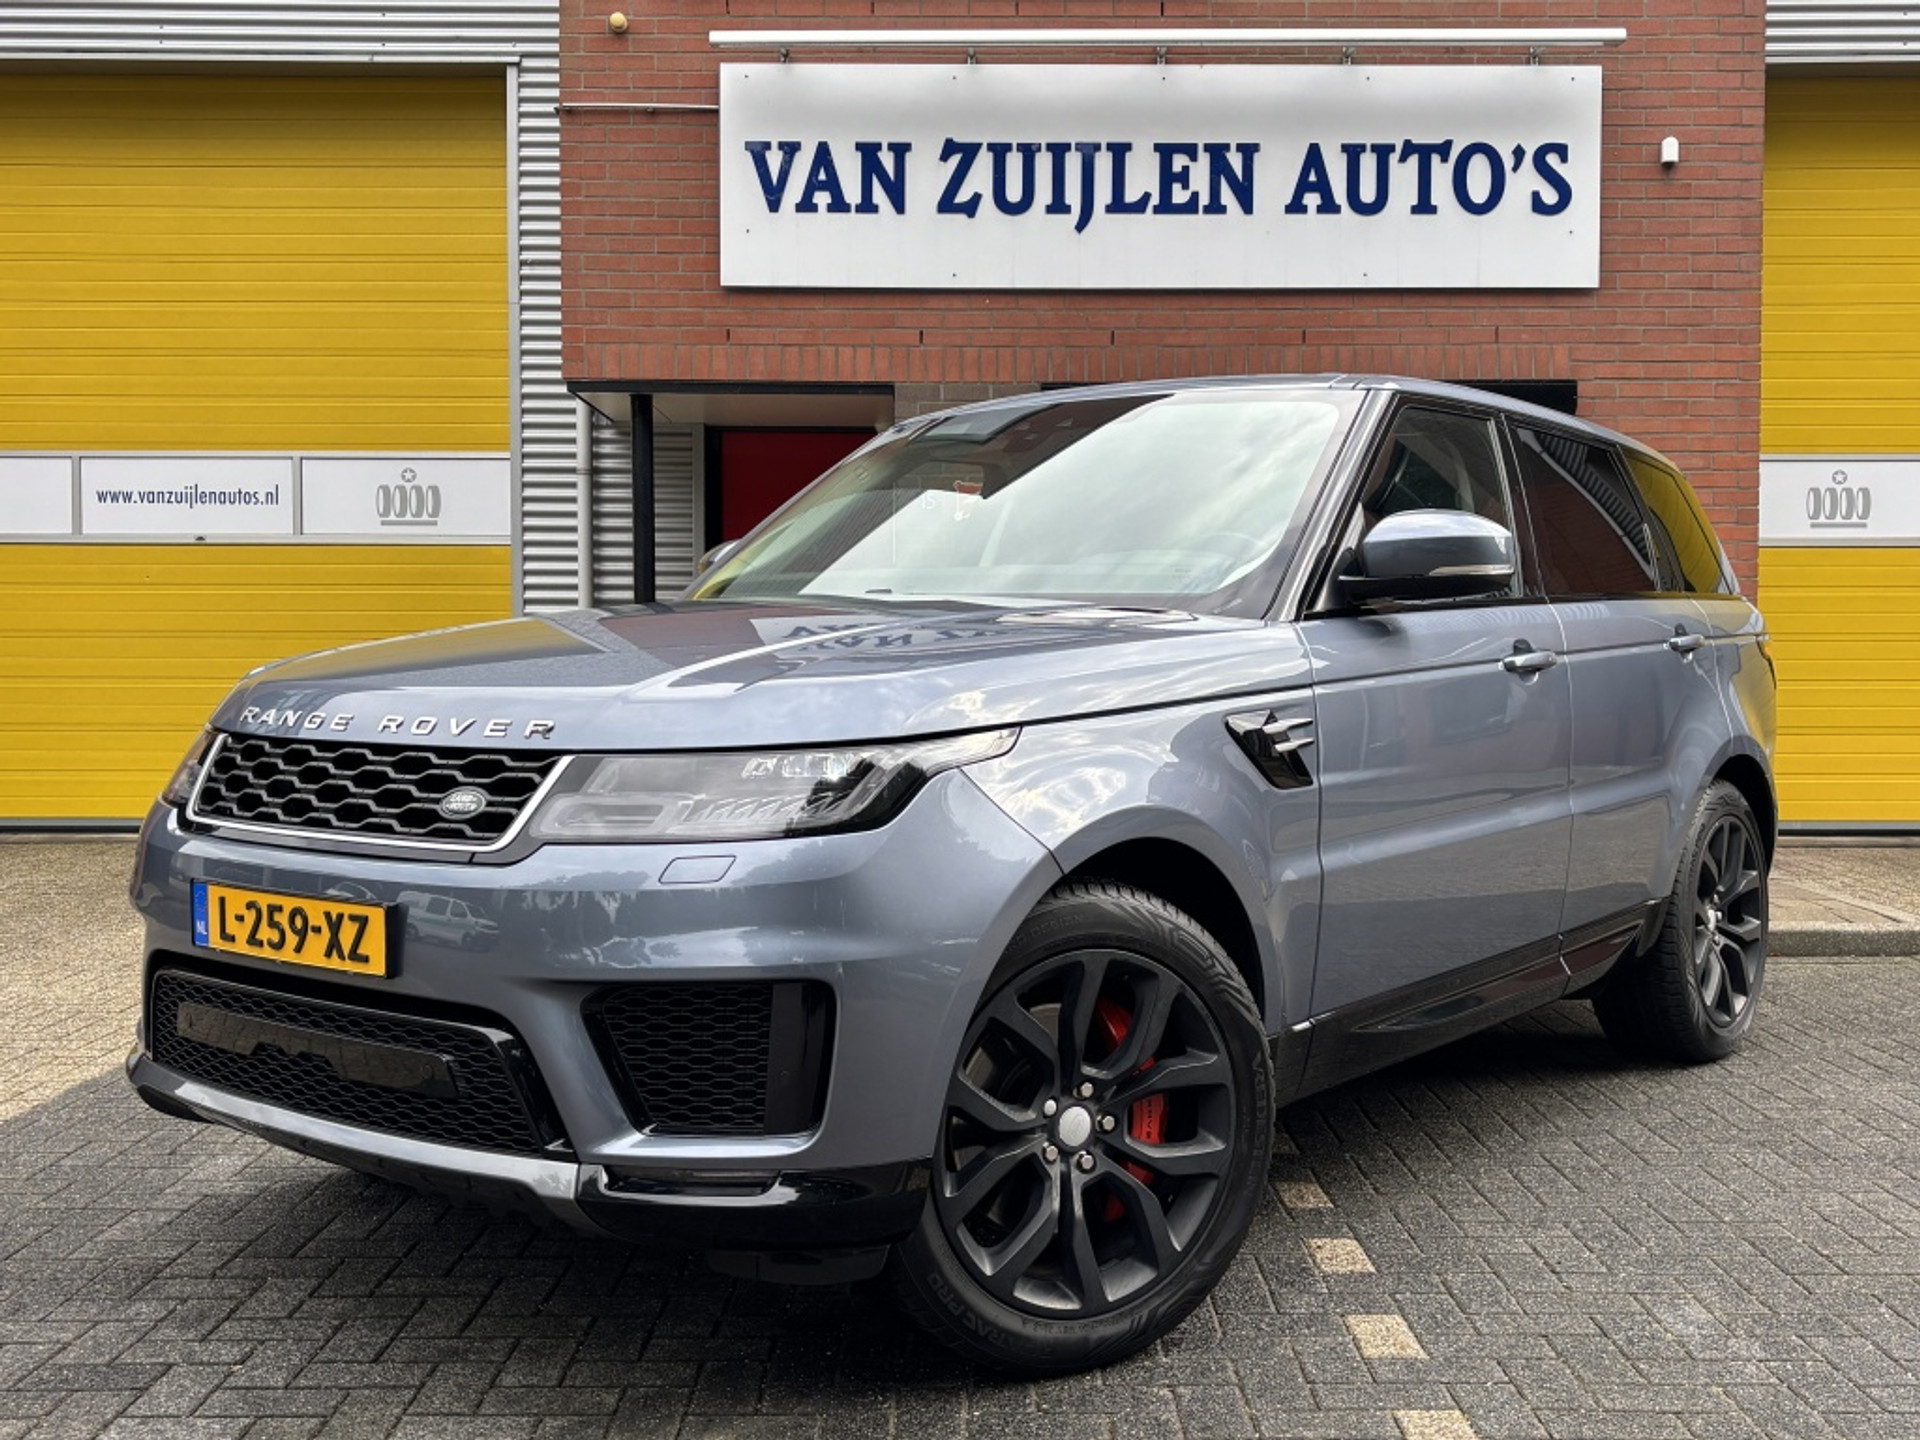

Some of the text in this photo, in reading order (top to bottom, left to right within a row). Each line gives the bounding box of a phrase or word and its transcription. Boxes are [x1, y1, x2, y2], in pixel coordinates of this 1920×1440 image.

[744, 138, 1574, 234] VAN ZUIJLEN AUTO'S
[96, 483, 279, 509] www.vanzuijlenautos.nl
[239, 706, 555, 740] RANGE ROVER
[217, 896, 370, 964] L-259-XZ
